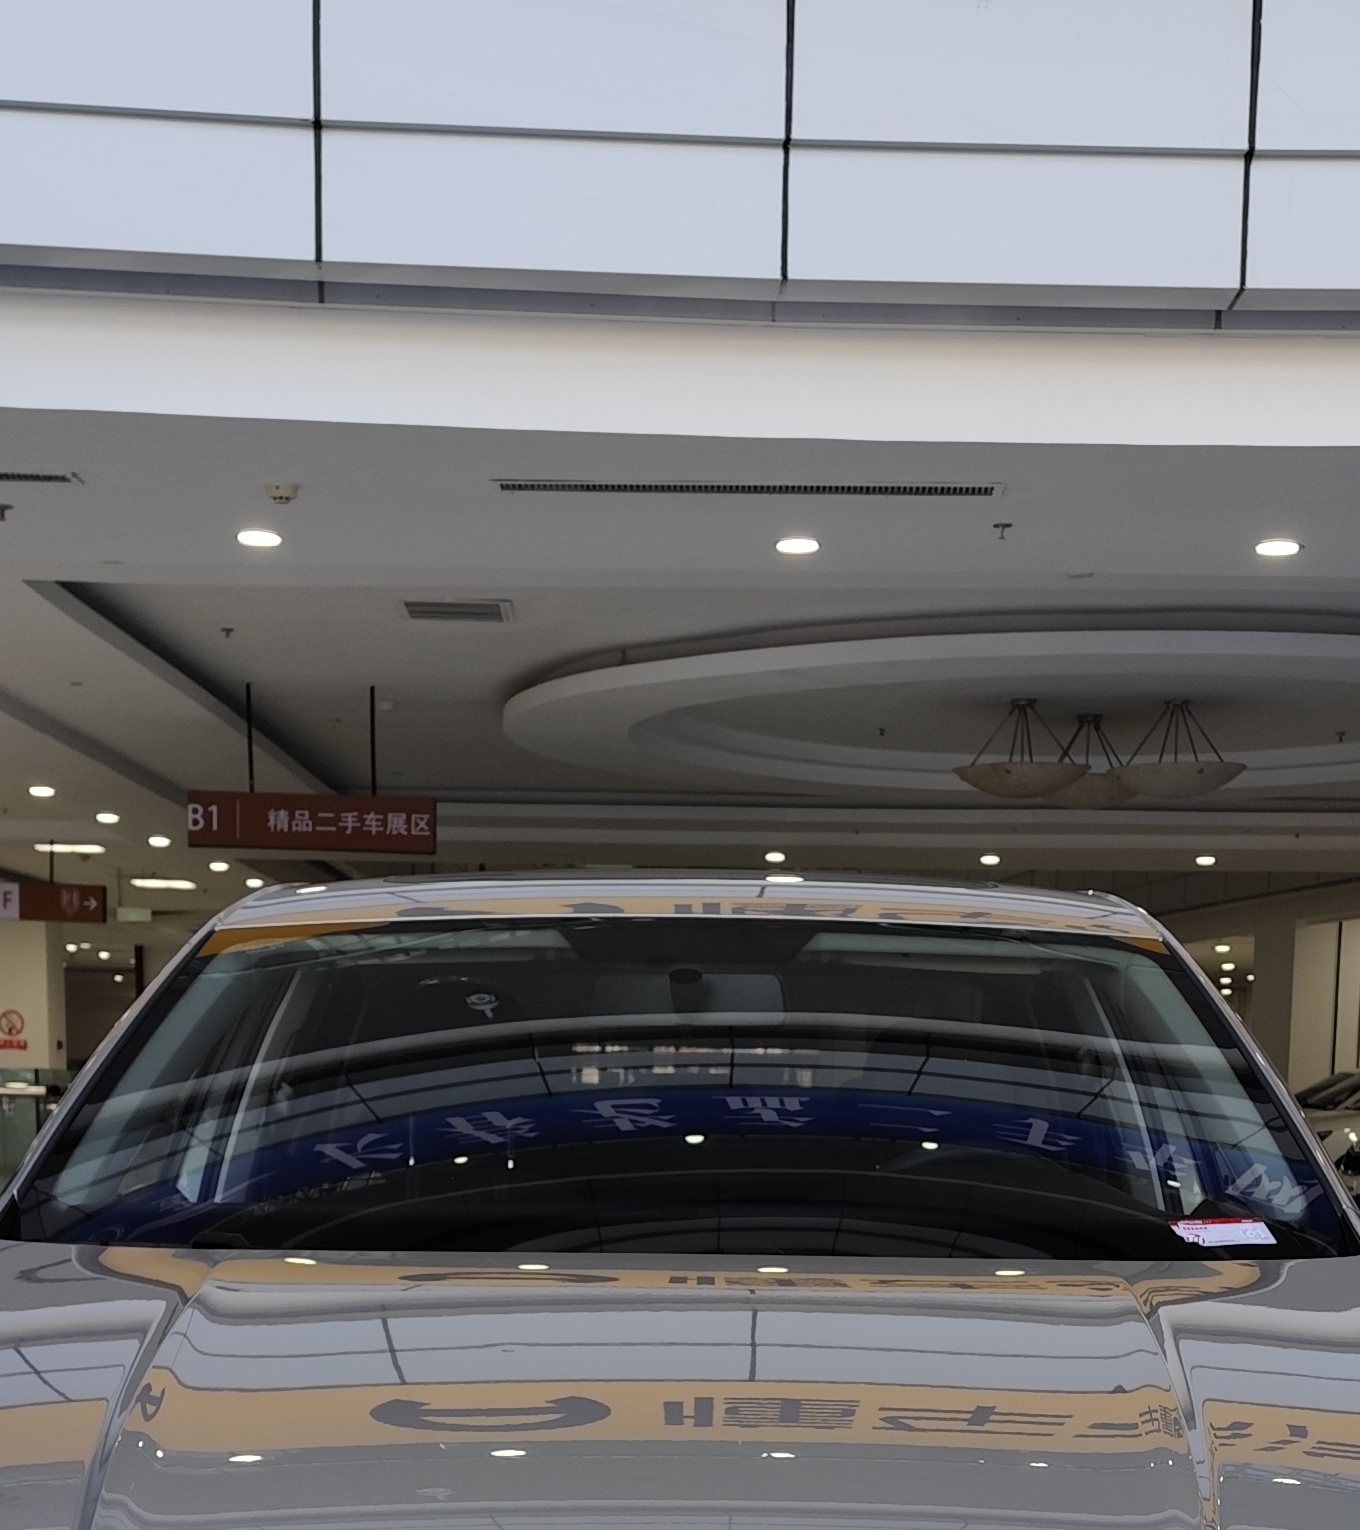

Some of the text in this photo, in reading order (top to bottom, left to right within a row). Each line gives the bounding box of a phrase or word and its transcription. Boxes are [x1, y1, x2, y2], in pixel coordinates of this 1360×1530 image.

[187, 803, 219, 832] B1
[267, 808, 431, 836] 精品二手车展区
